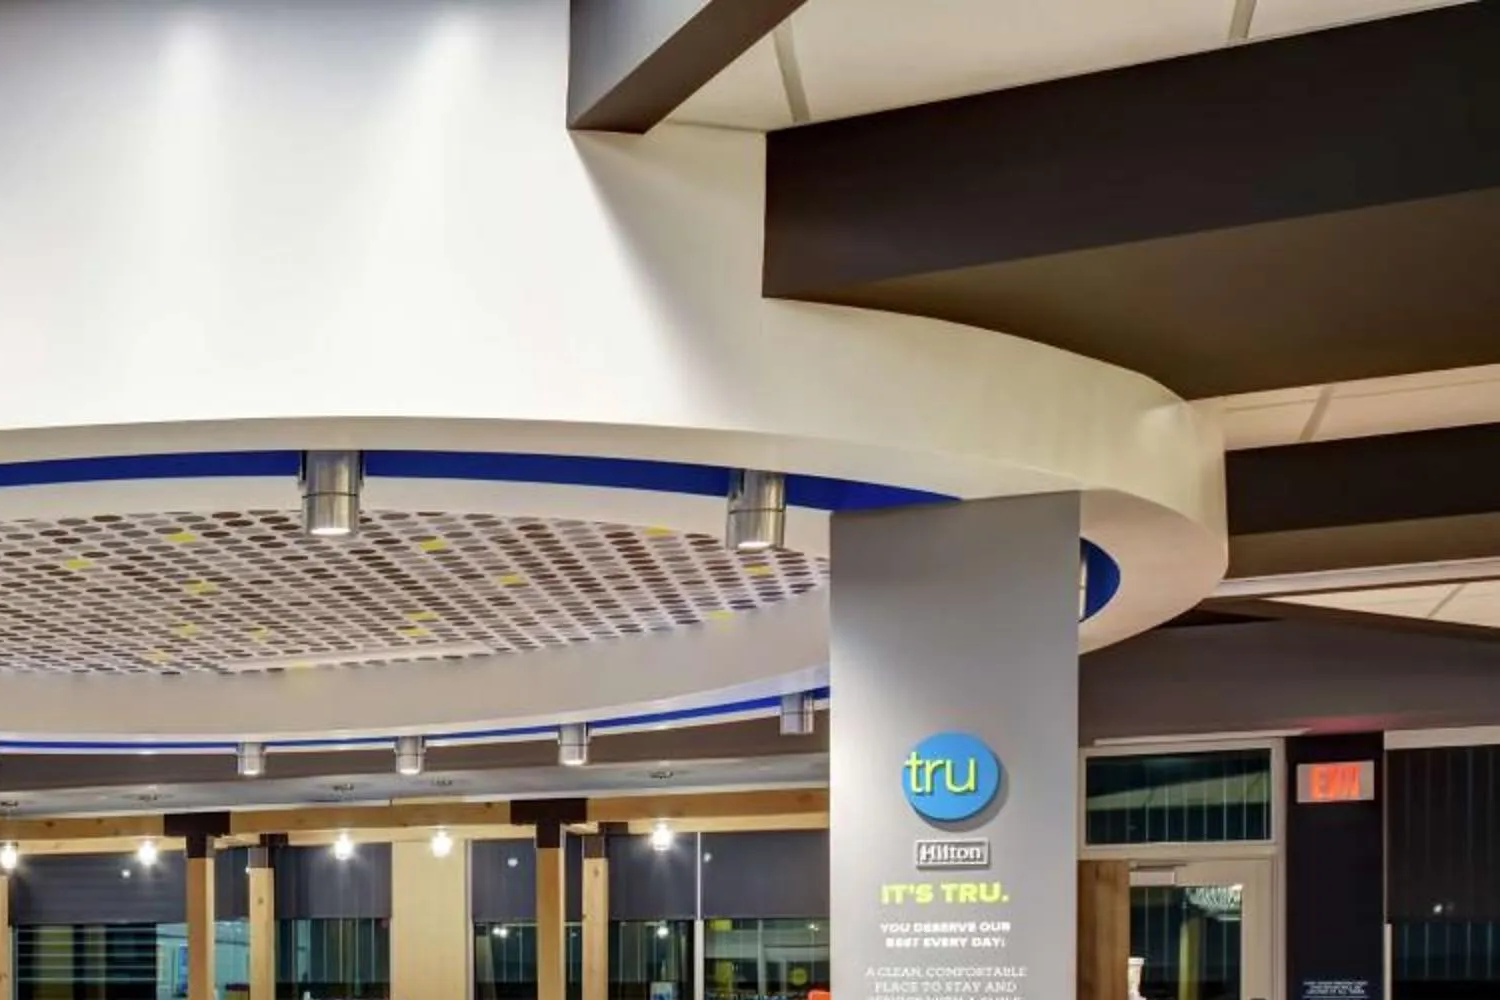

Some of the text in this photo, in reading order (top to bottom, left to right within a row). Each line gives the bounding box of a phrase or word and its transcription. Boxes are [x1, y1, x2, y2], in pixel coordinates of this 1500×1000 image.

[904, 751, 975, 793] tru
[919, 843, 982, 862] Hilton
[881, 881, 1010, 905] IT'S TRU.
[880, 921, 1012, 933] YOU DESERVE OUR
[885, 936, 919, 948] BEST
[923, 936, 968, 948] EVERY
[866, 967, 875, 977] A
[875, 981, 1017, 993] PLACE TO STAY AND
